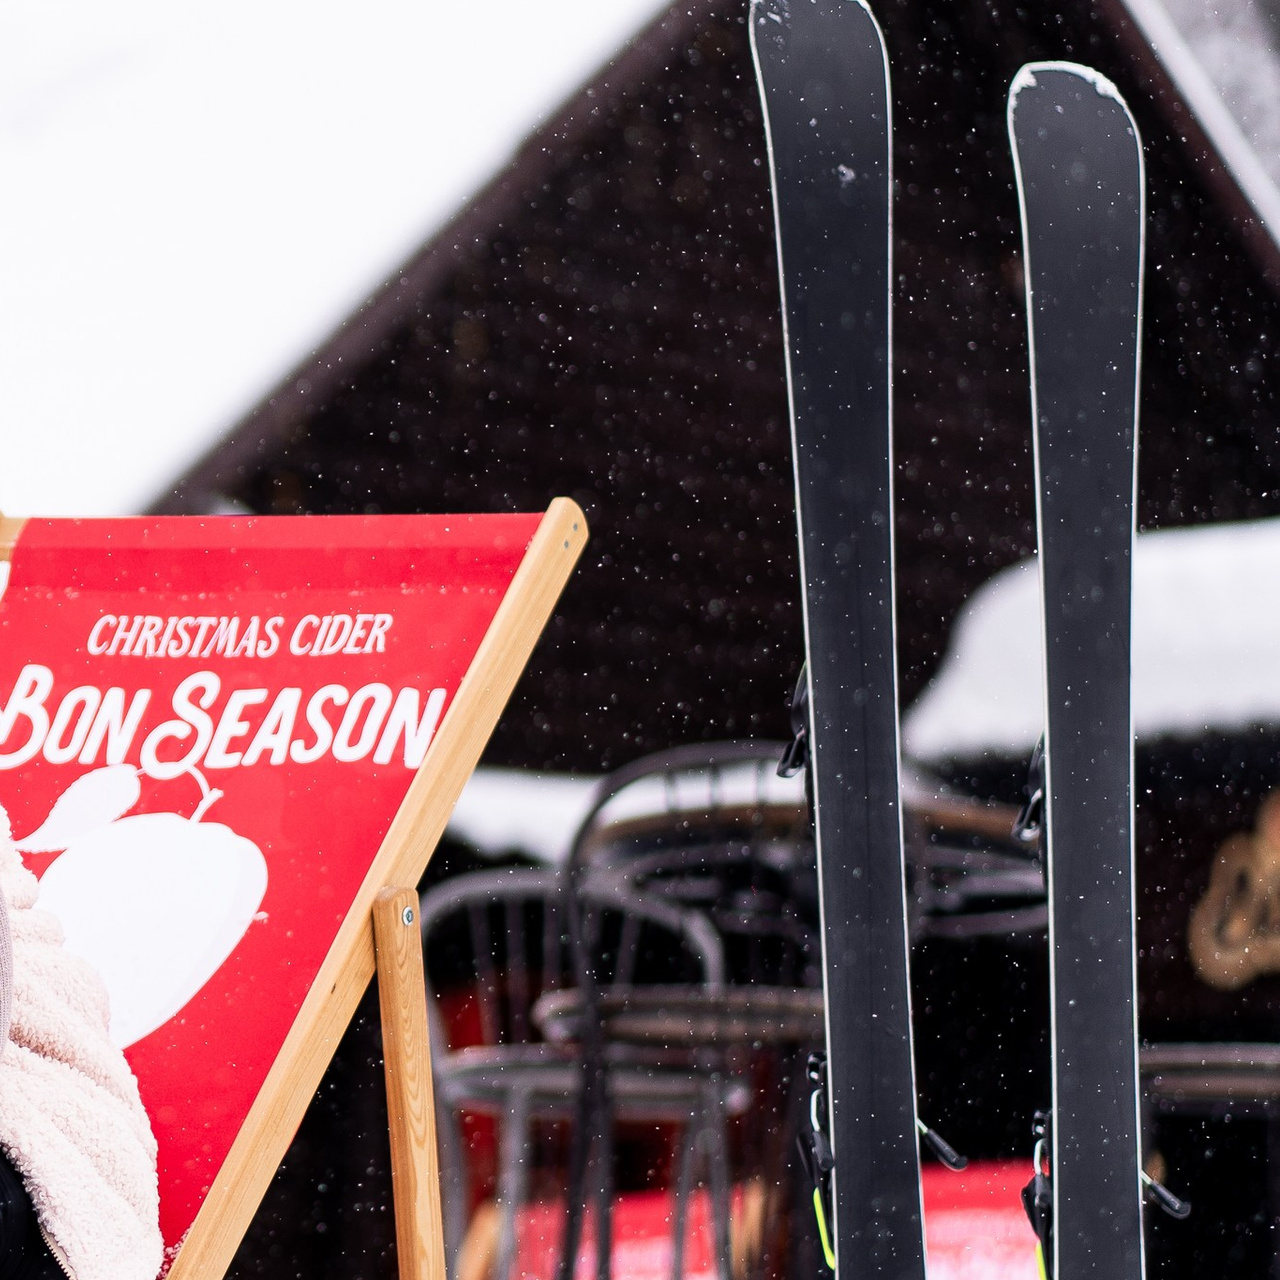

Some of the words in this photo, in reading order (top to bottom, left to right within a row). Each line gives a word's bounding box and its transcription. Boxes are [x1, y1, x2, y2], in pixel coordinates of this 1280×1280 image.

[86, 613, 285, 658] CHRISTMAS
[289, 612, 394, 656] CIDER
[139, 670, 447, 780] SEASON
